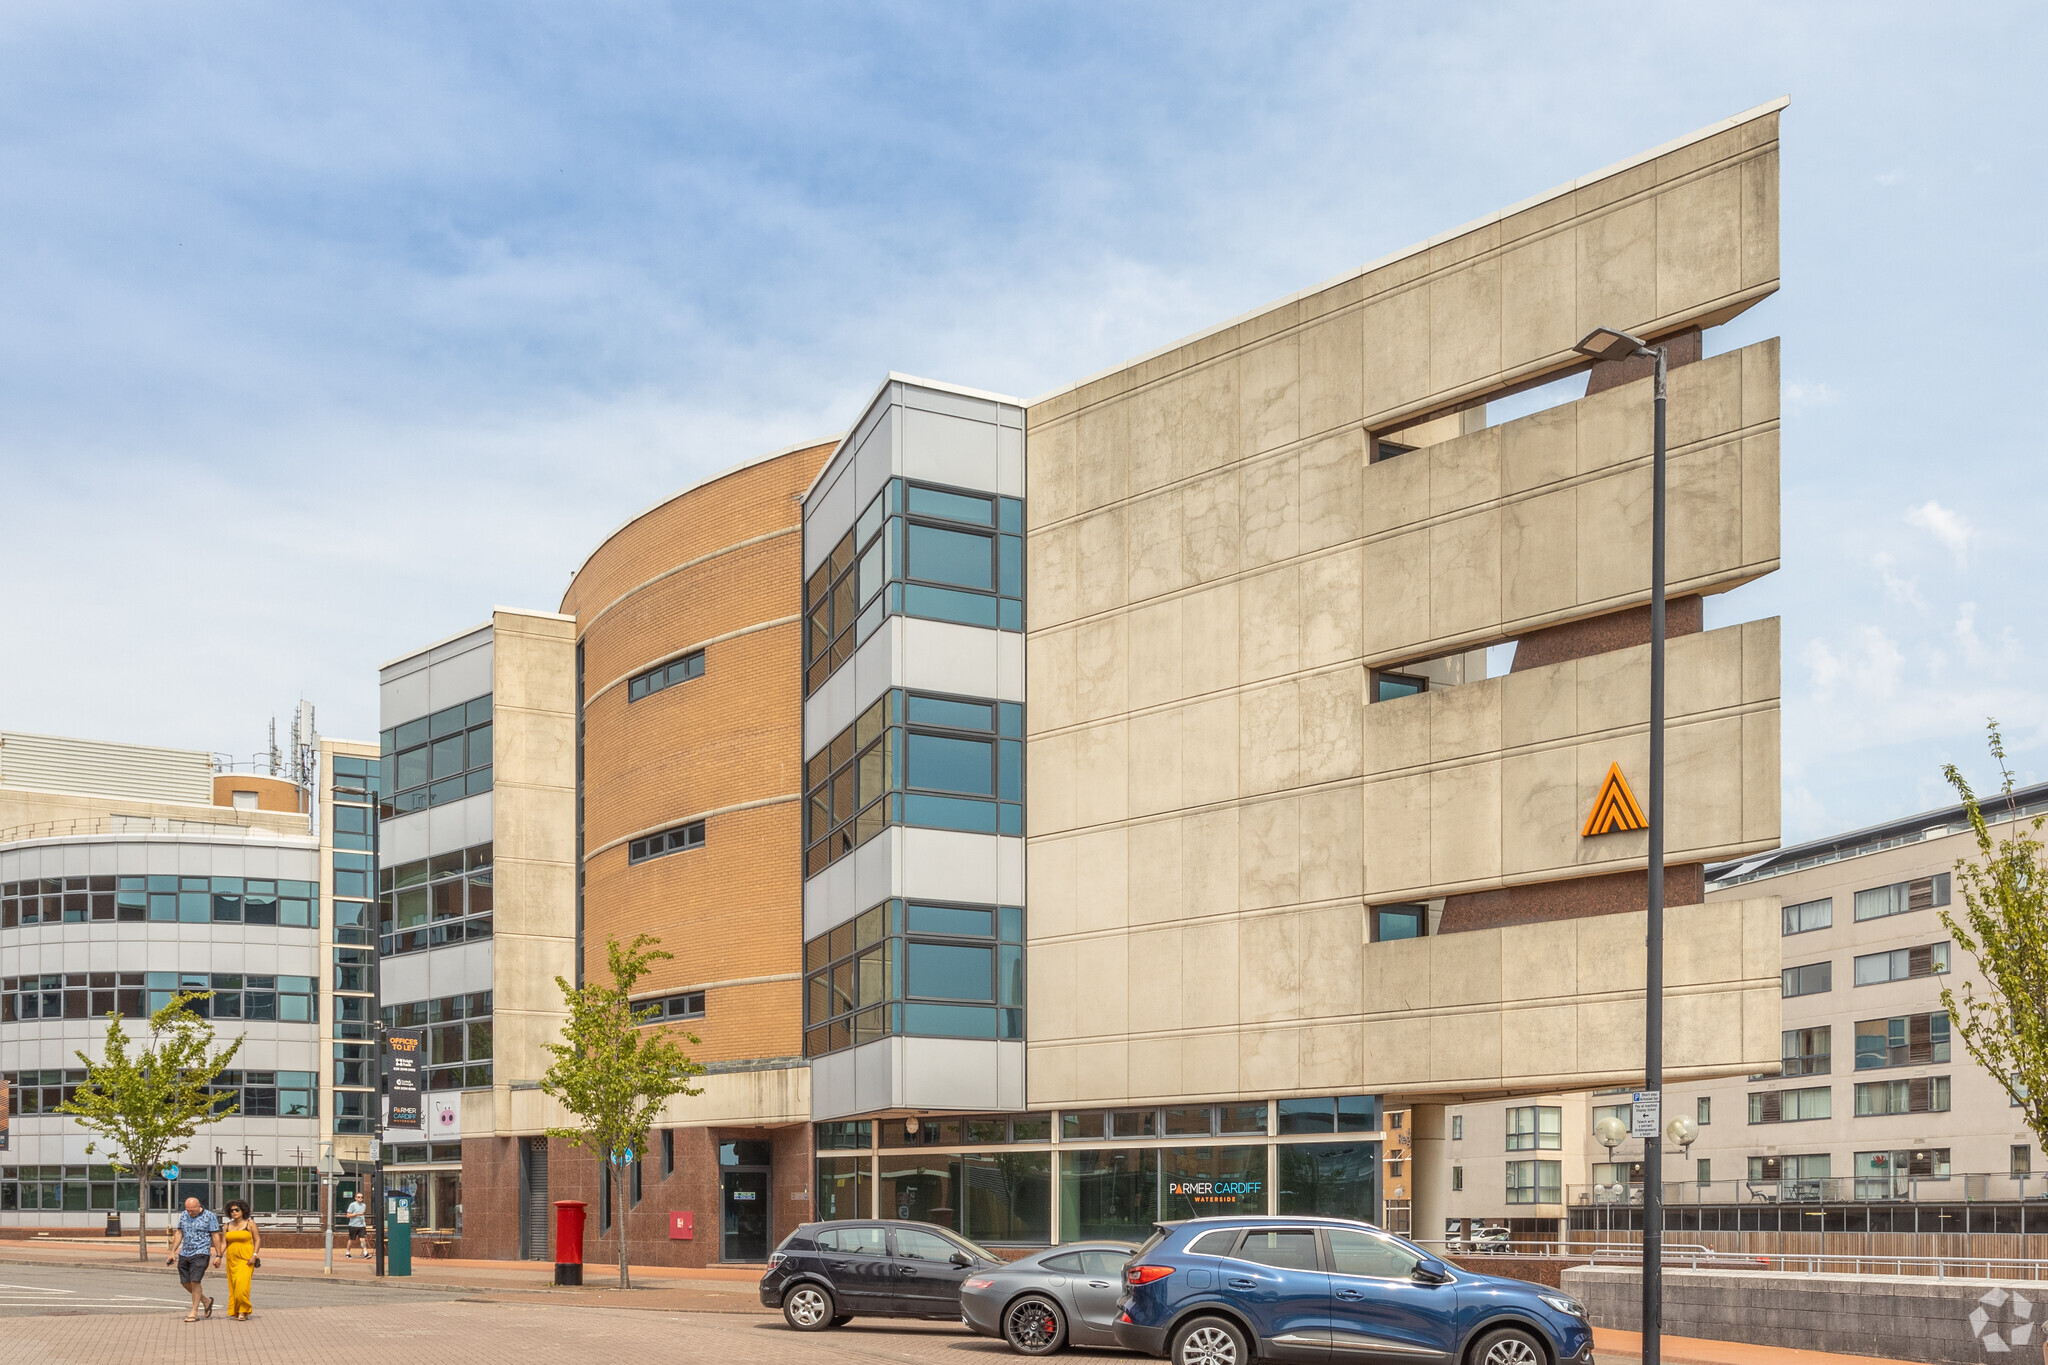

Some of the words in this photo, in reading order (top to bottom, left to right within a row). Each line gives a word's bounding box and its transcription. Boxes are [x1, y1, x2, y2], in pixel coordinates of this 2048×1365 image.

[390, 1037, 418, 1046] OFFICES
[393, 1106, 417, 1114] PARMER
[1169, 1182, 1212, 1194] PARMER
[1214, 1182, 1261, 1194] CARDIFF
